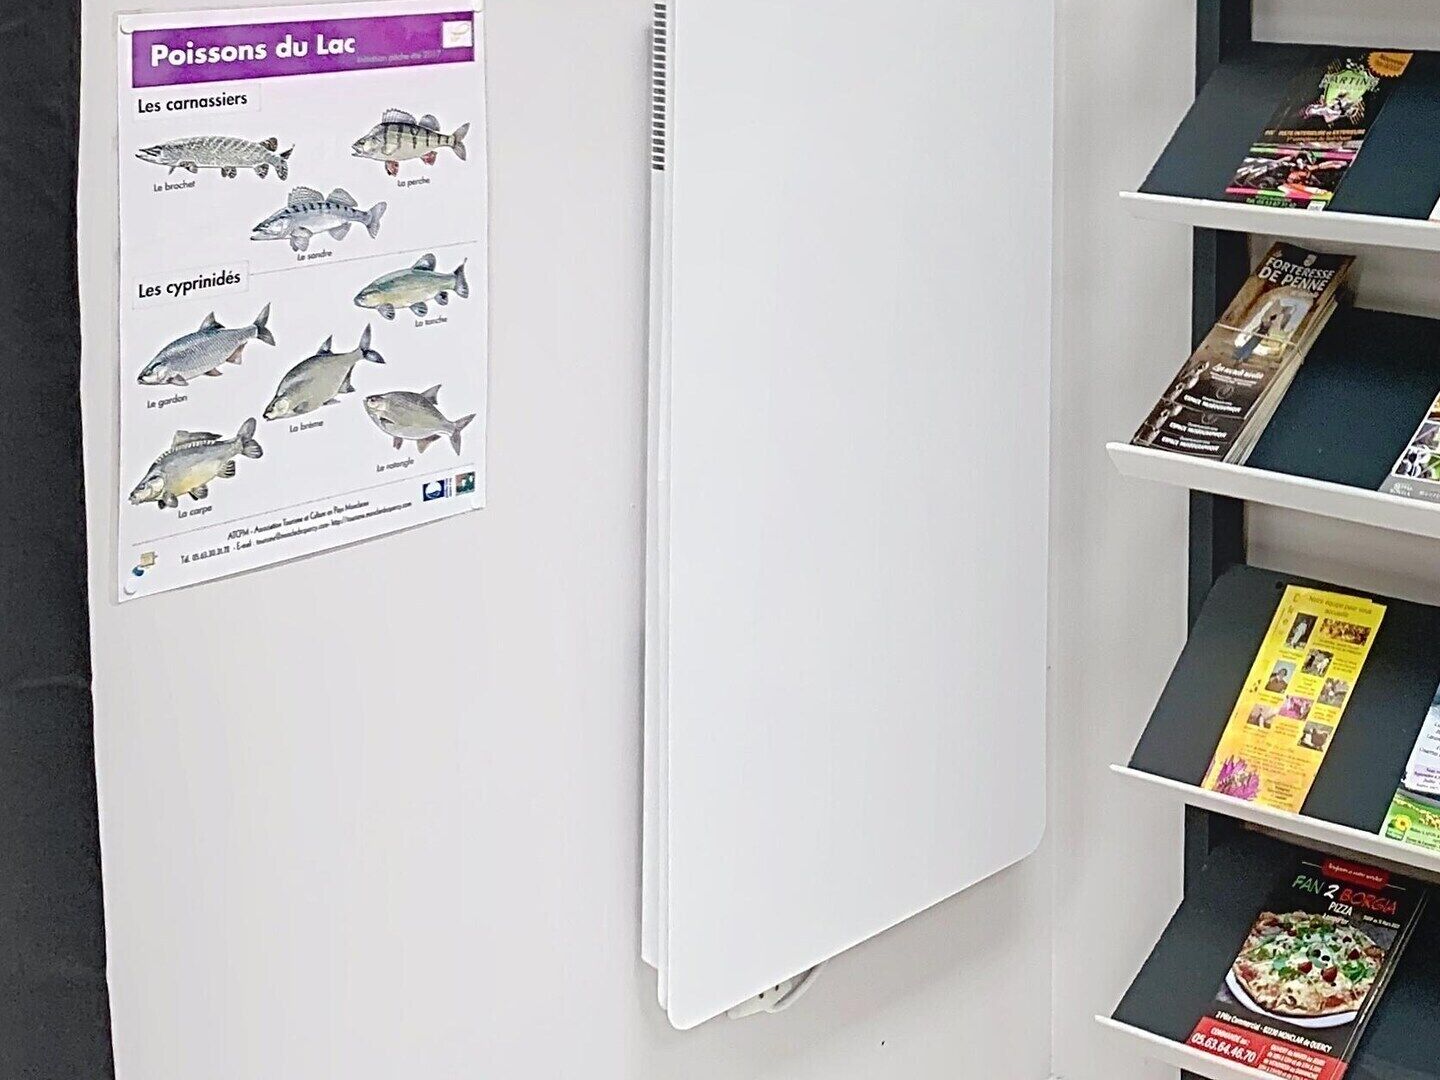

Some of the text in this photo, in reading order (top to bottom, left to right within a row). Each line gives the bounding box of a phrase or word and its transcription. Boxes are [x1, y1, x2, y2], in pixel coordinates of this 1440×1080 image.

[151, 34, 356, 67] Poissons du Lac
[138, 92, 247, 113] Les carnassiers
[166, 179, 195, 192] brochet
[409, 176, 431, 190] perche
[1265, 257, 1335, 279] FORTERESSE
[138, 269, 241, 299] Les cyprinidés
[1258, 266, 1329, 292] DE PENNE
[160, 392, 188, 409] gardon
[190, 504, 212, 518] carpe
[1291, 875, 1397, 915] FAN 2 BORGIA
[1328, 902, 1353, 916] PIZZA
